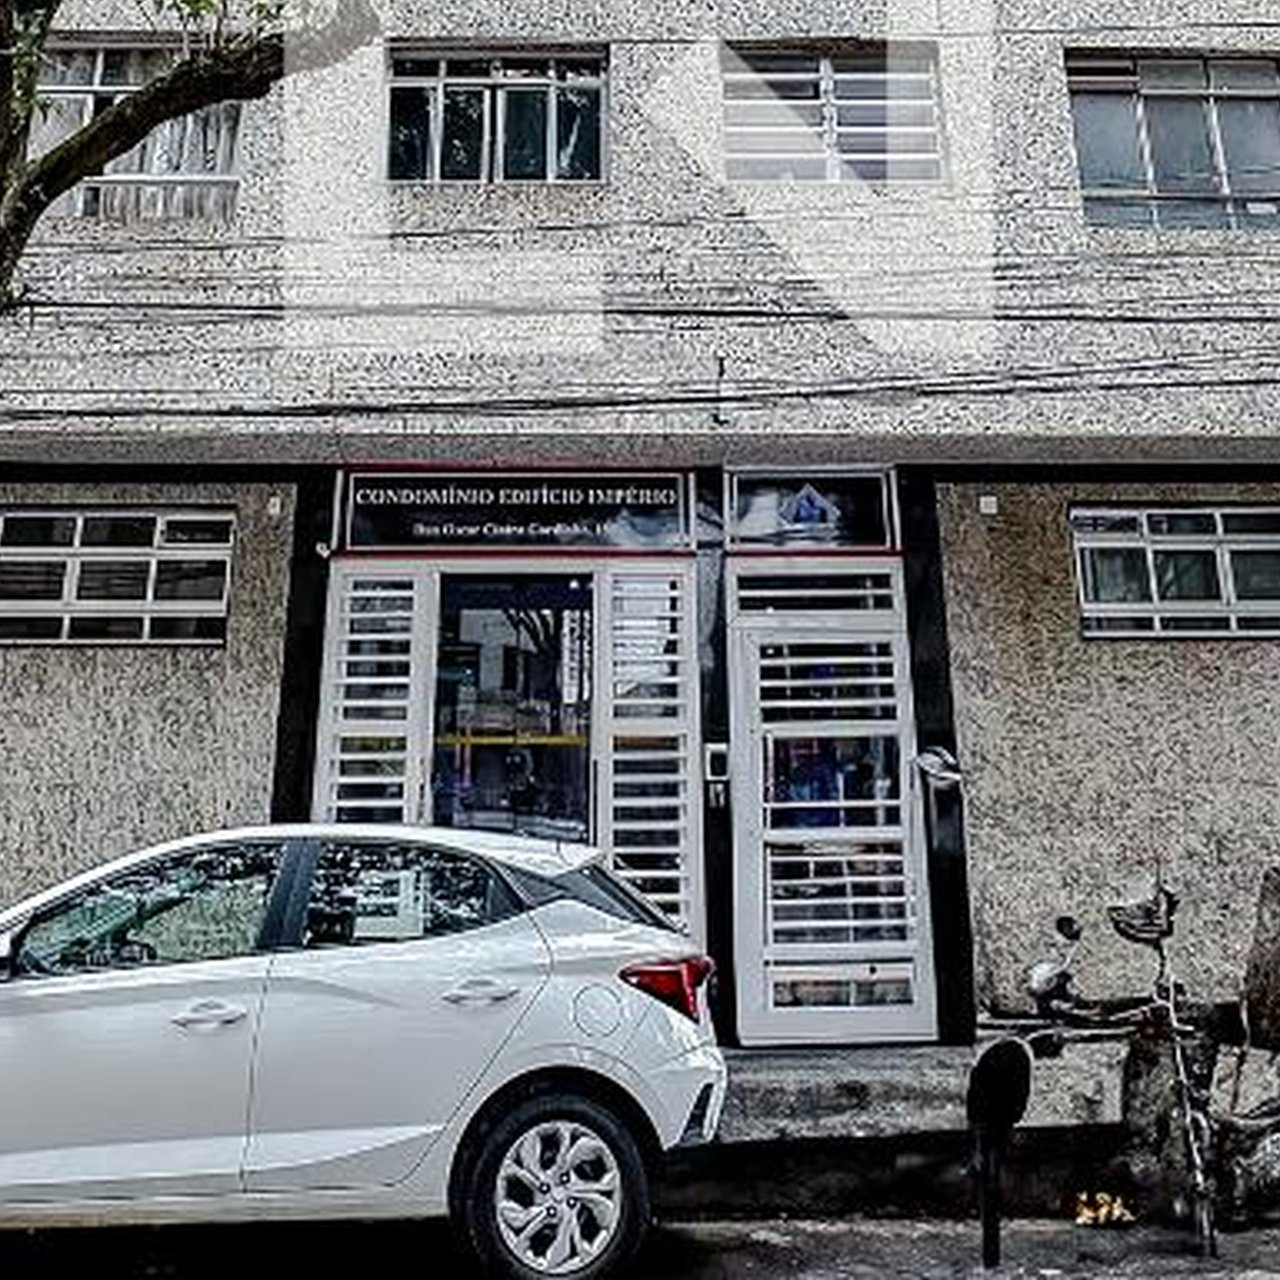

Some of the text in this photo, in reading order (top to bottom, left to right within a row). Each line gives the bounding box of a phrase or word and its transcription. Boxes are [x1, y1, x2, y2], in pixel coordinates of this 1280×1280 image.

[355, 483, 678, 505] CONDOMÍNIO EDIFÍCIO IMPÉRIO
